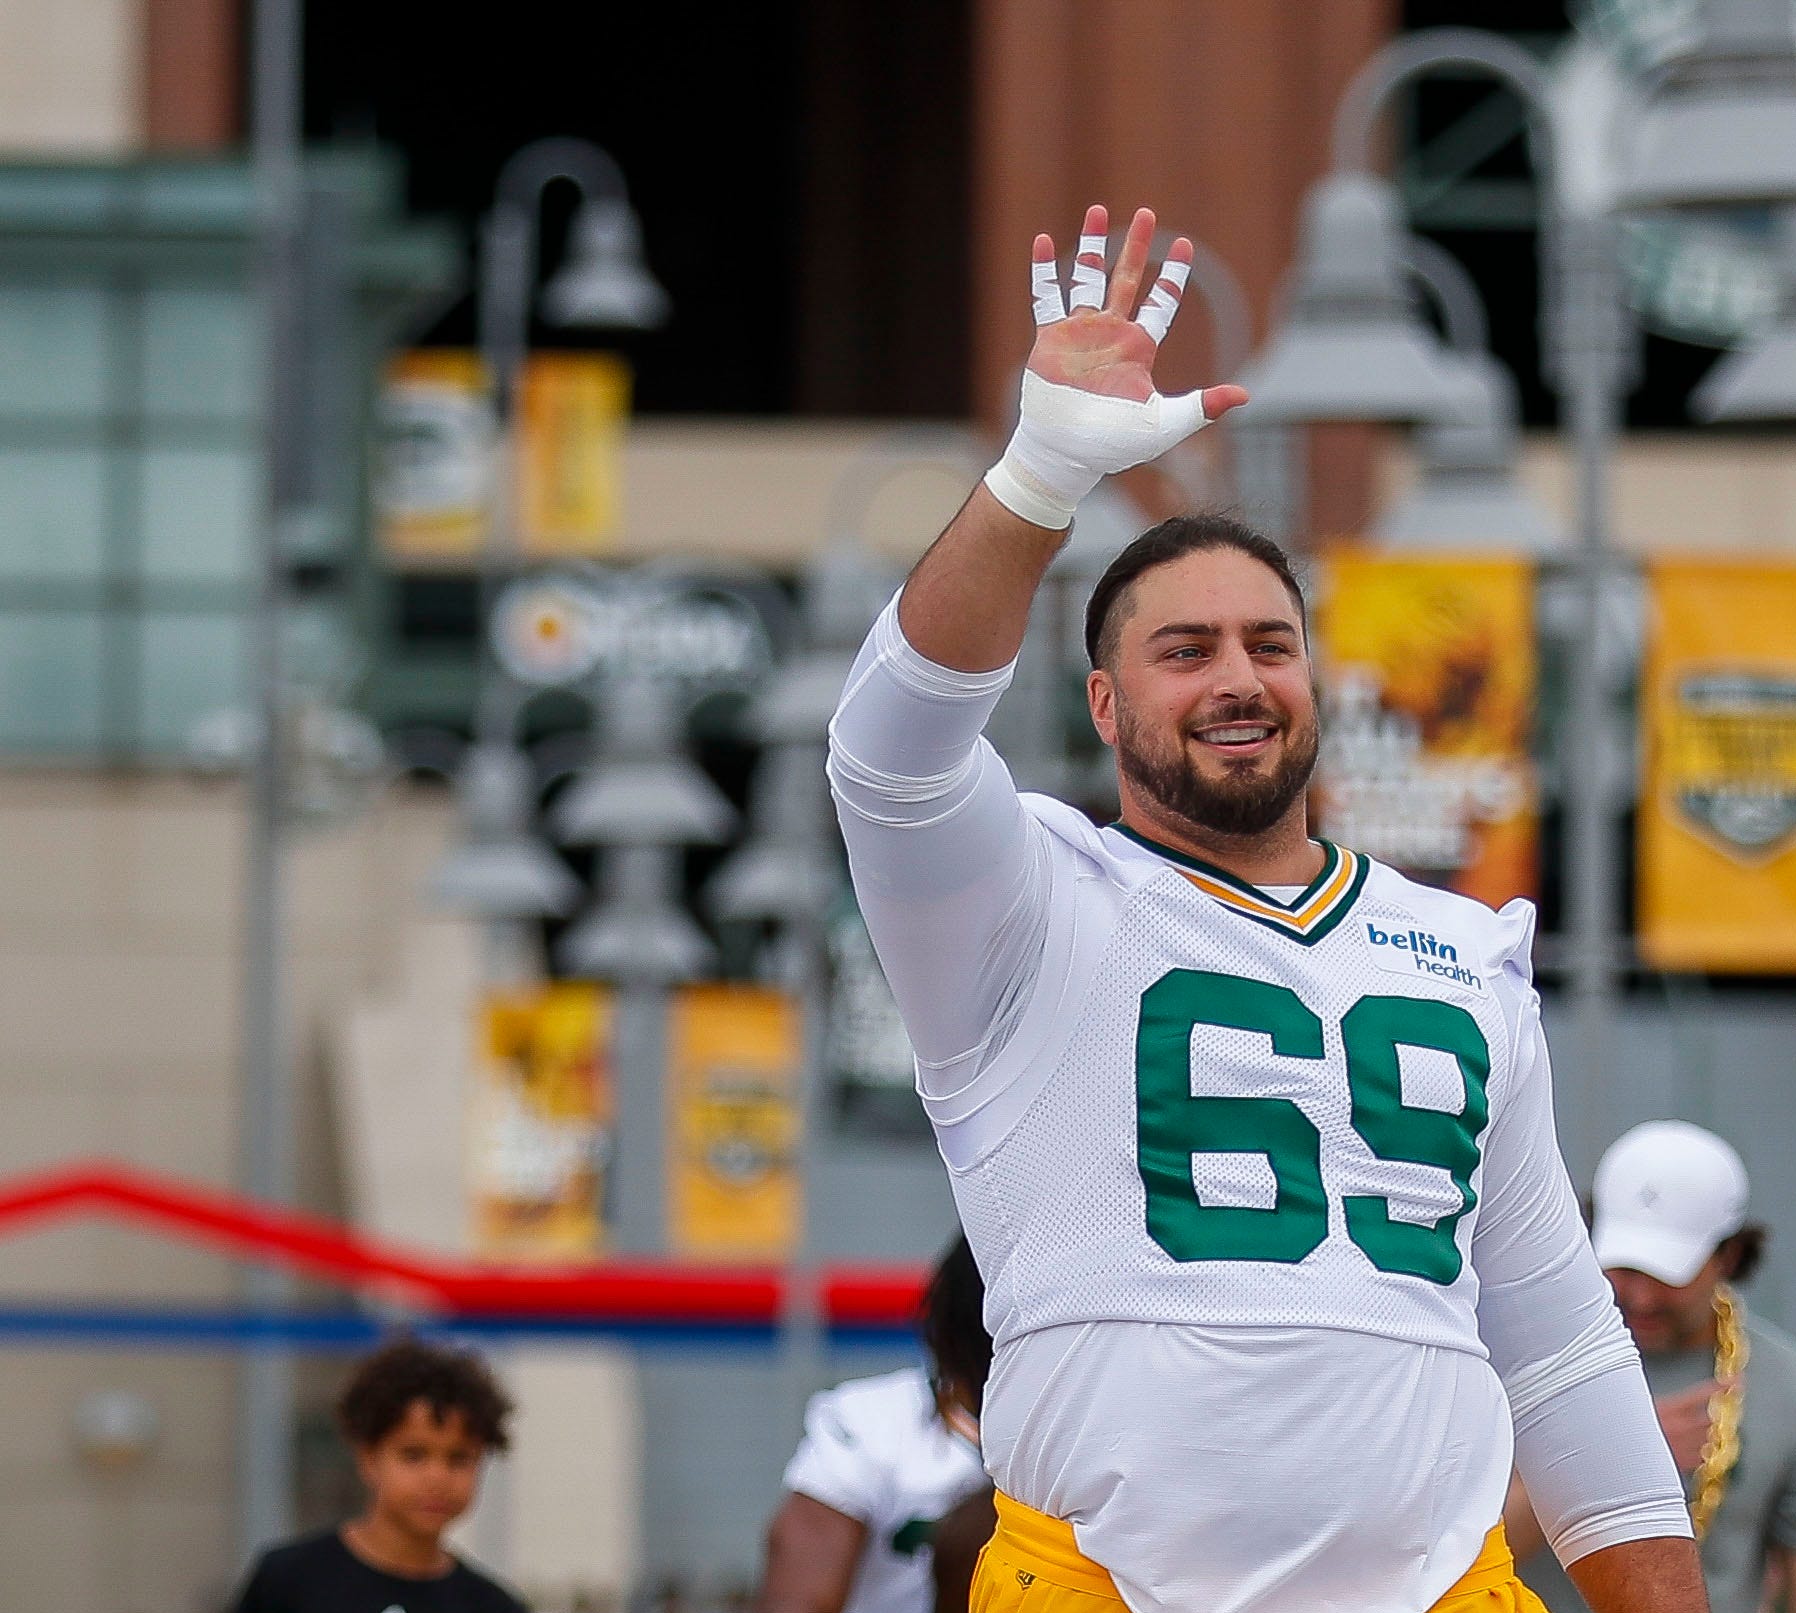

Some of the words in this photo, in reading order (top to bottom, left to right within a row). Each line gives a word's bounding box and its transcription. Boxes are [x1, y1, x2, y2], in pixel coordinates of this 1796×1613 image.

[1366, 922, 1458, 963] bellin
[1414, 953, 1482, 990] health
[1136, 967, 1489, 1287] 69
